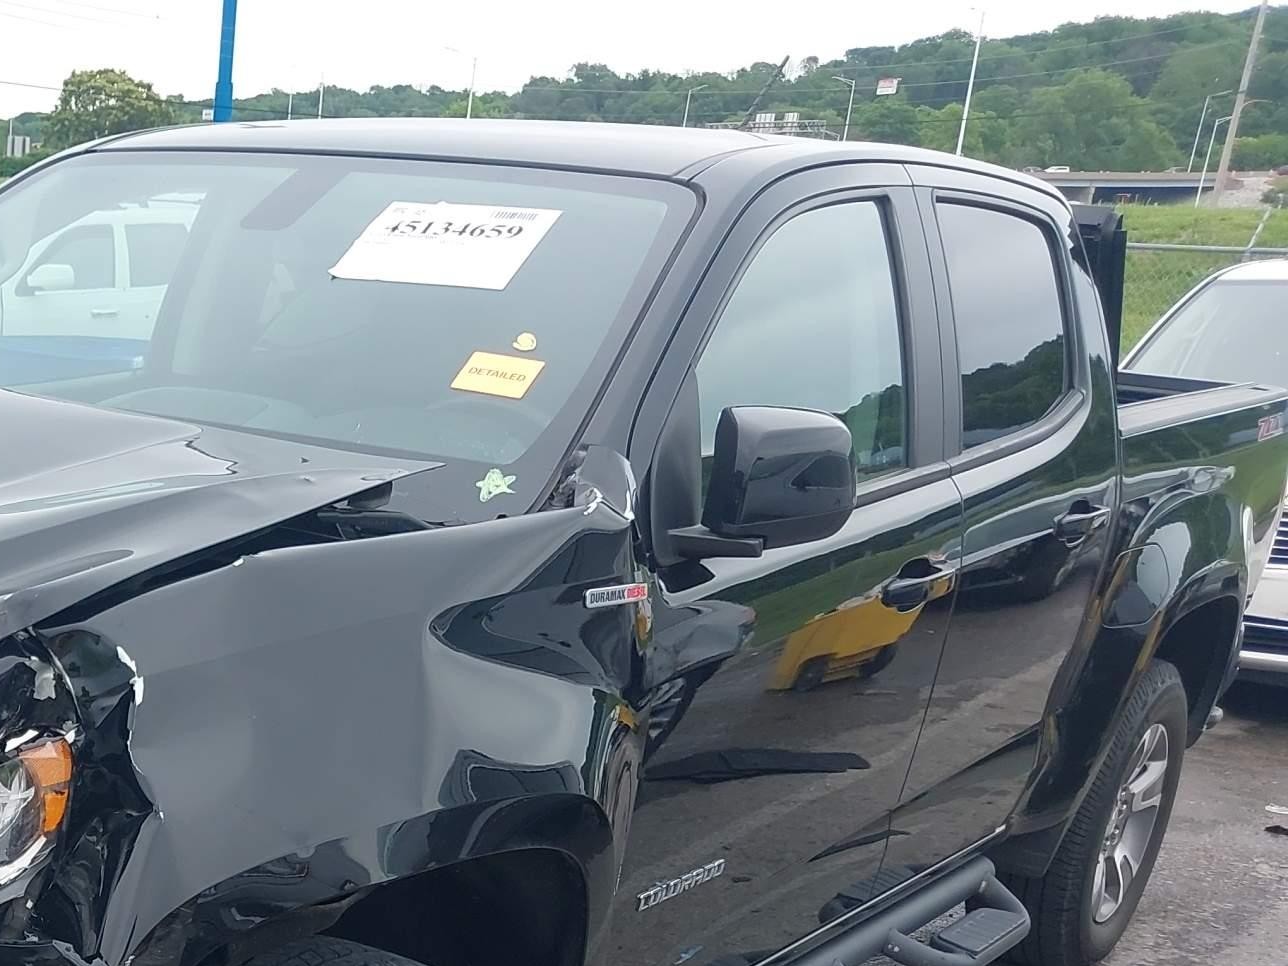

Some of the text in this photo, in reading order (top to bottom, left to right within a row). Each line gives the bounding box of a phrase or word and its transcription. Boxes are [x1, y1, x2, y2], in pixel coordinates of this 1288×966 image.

[385, 220, 524, 239] 45134659
[467, 366, 527, 383] DETAILED
[589, 588, 626, 605] DURAMAX
[637, 858, 726, 913] COLORADO
